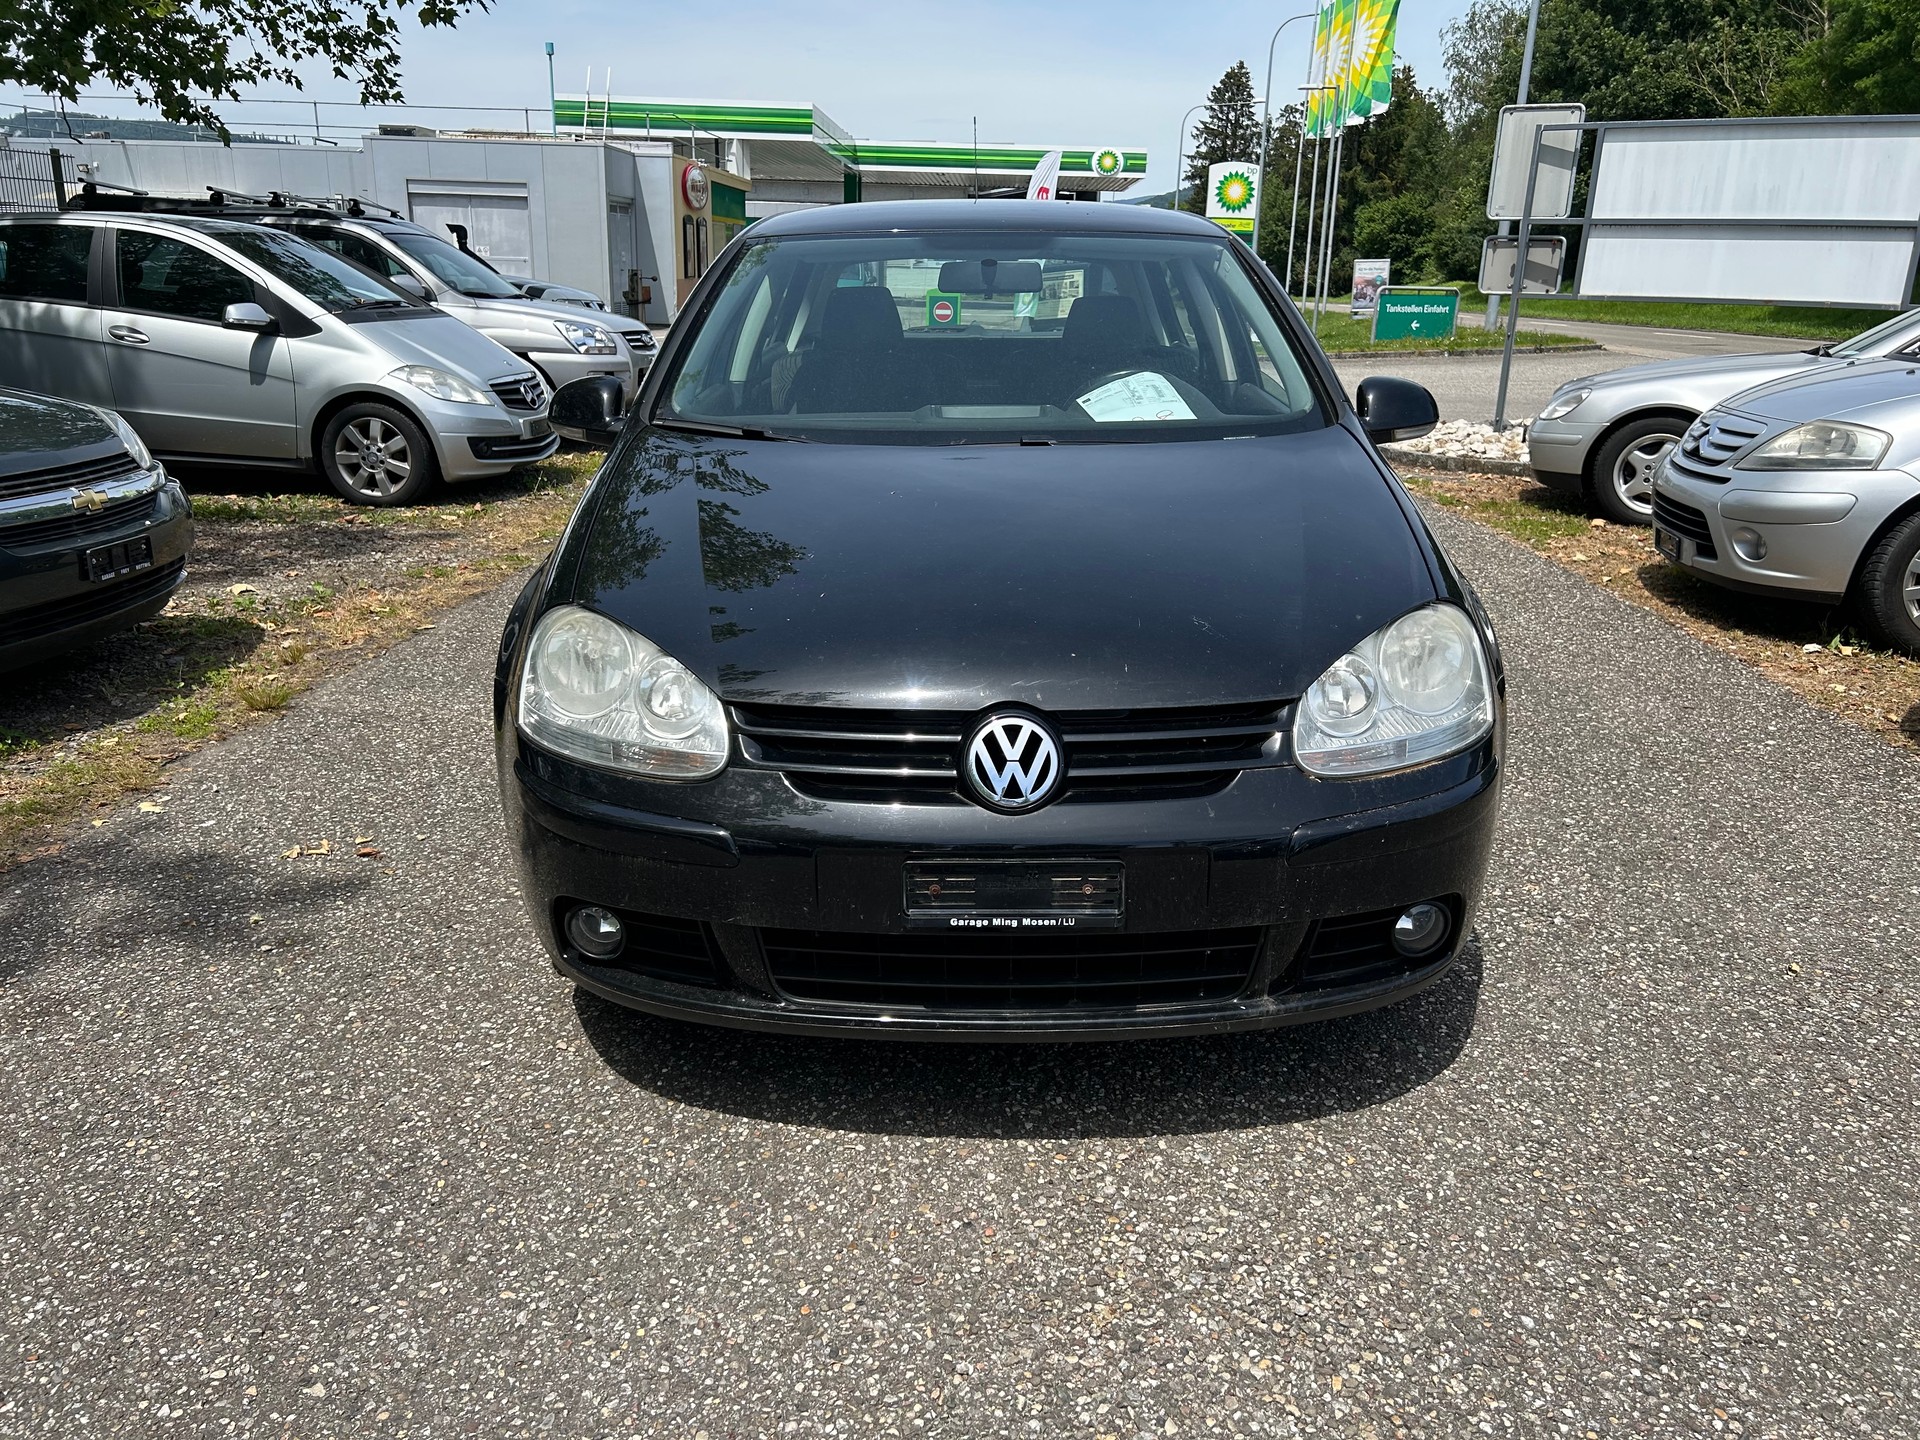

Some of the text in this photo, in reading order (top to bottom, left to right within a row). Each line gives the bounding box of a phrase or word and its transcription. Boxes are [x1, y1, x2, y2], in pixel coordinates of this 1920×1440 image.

[1247, 166, 1258, 175] bp
[1386, 304, 1449, 313] Tankstellen Einfahrt
[969, 716, 1059, 806] VW
[950, 918, 989, 928] Garage
[992, 918, 1018, 928] Ming
